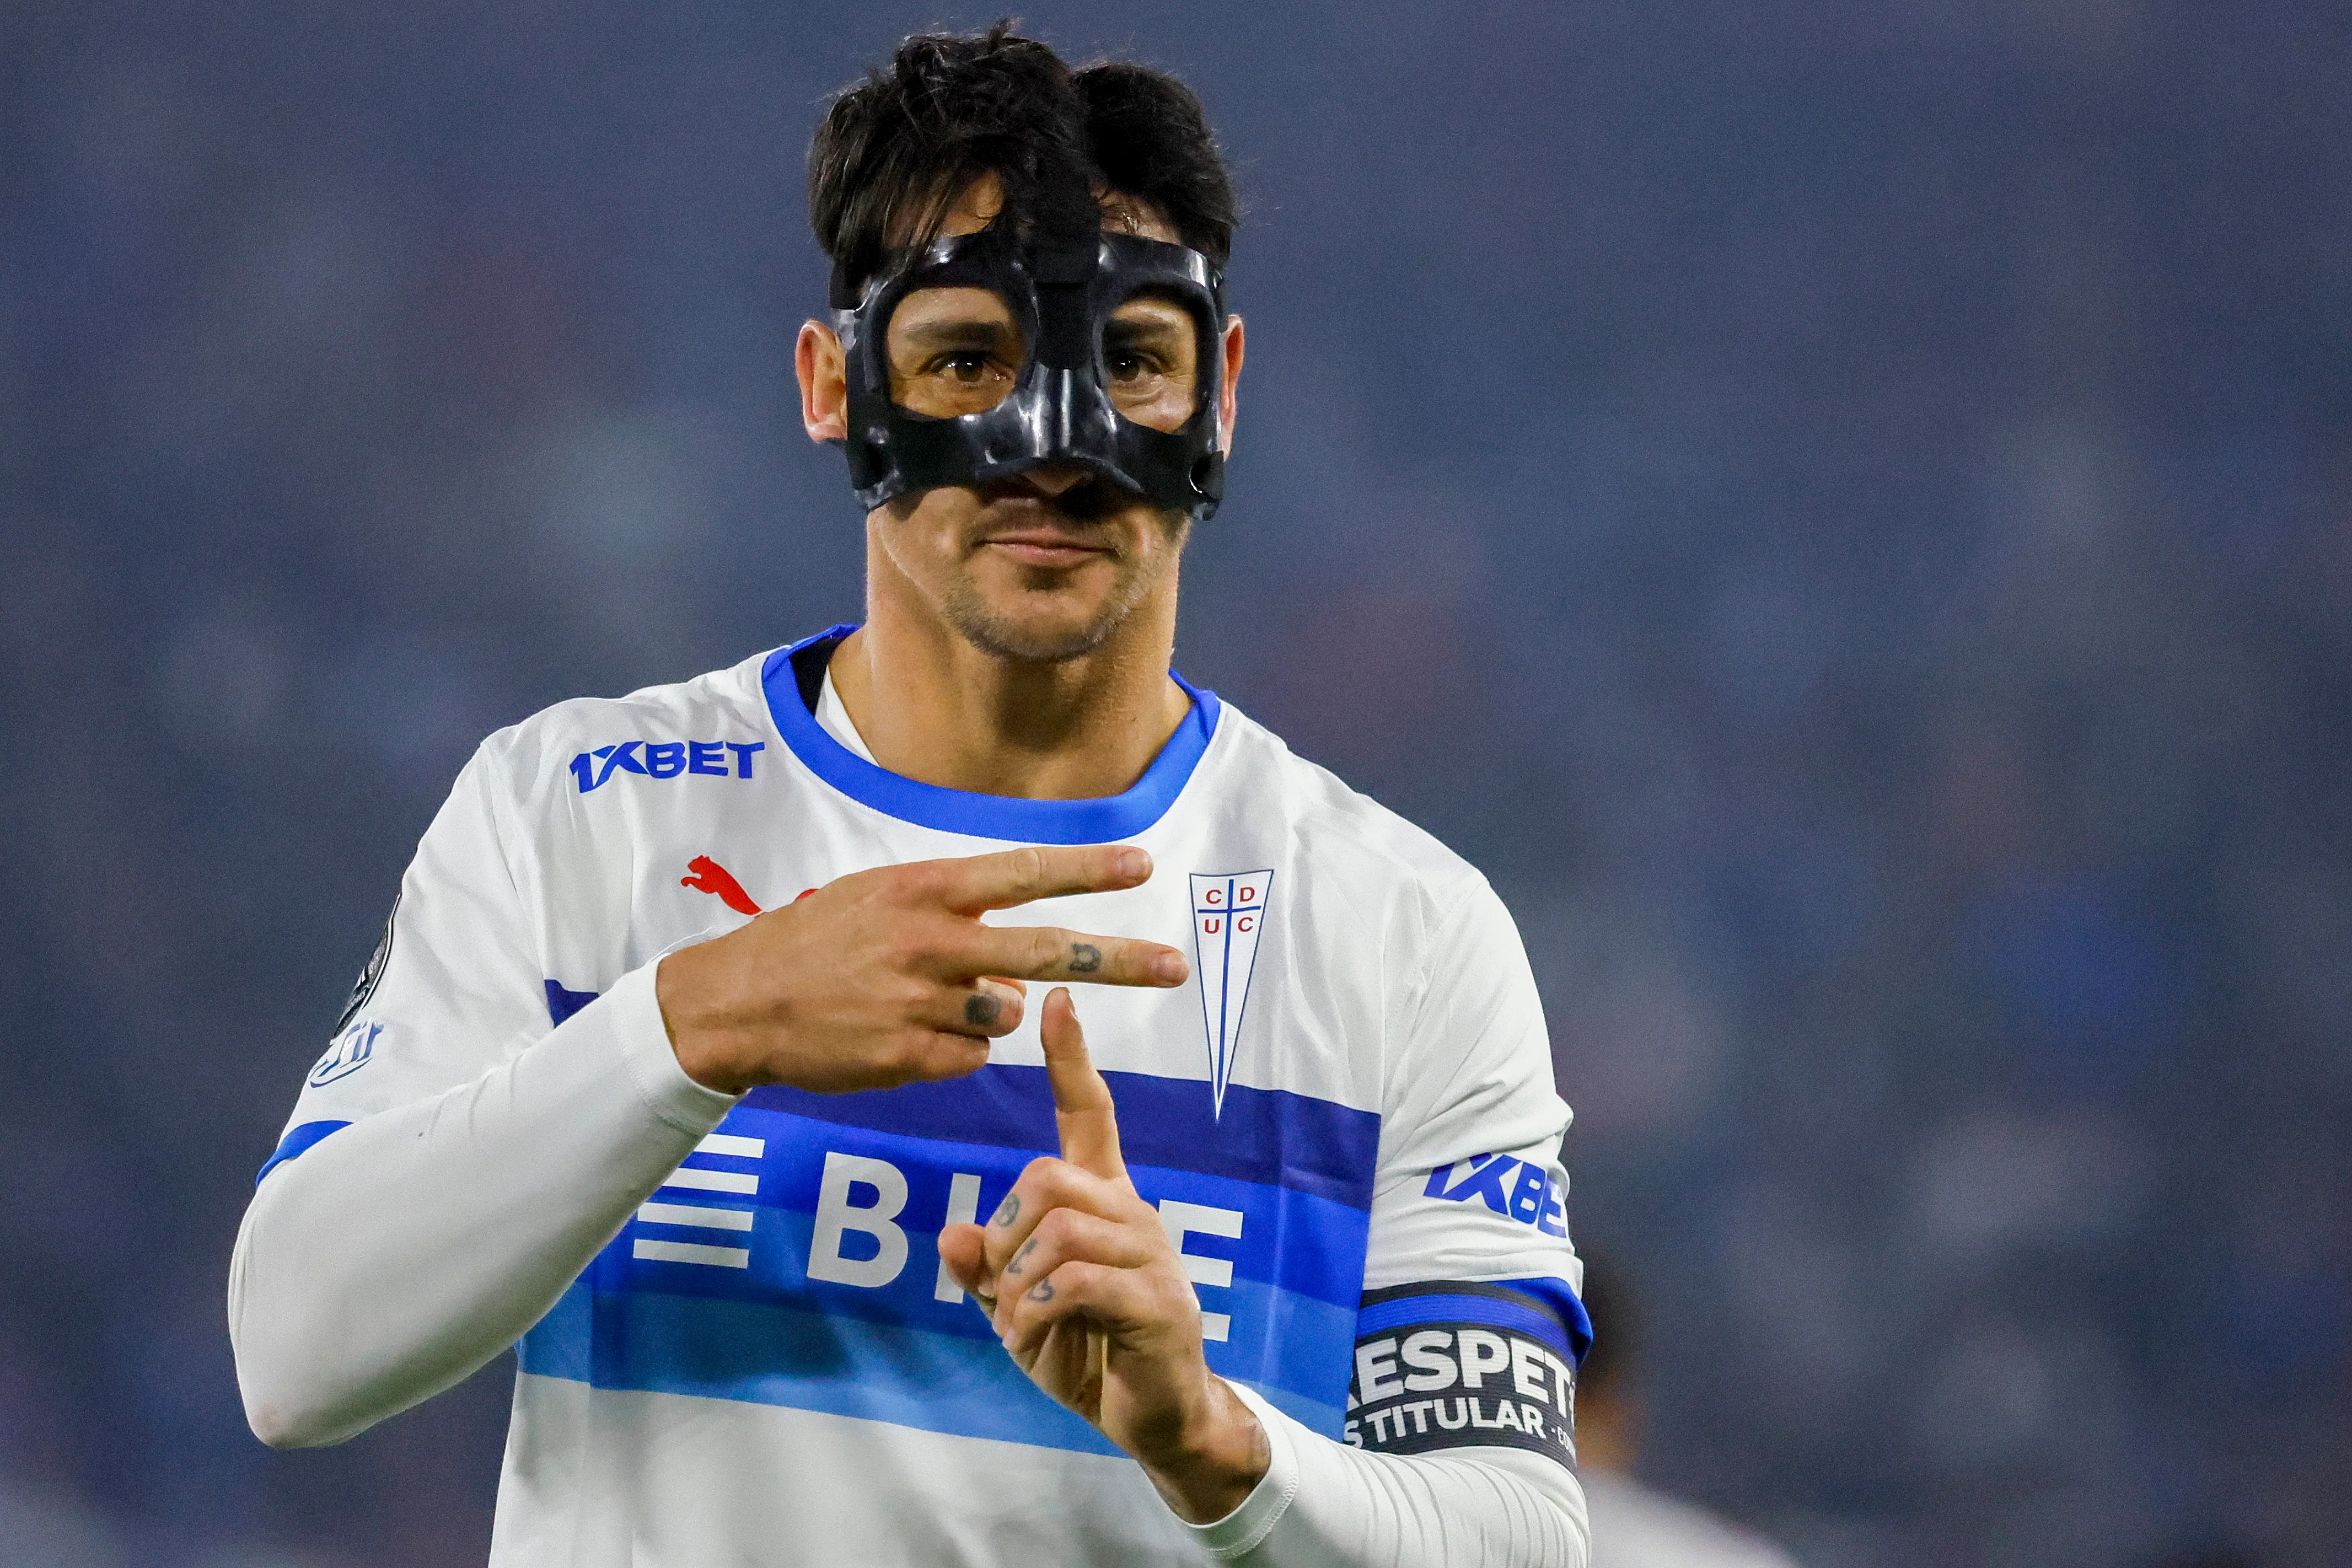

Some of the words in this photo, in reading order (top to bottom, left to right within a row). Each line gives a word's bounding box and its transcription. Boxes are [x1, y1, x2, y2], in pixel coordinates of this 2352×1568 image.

[570, 742, 765, 793] 1XBET
[807, 1151, 1243, 1342] BIE
[1347, 1329, 1576, 1430] ESPET
[1365, 1397, 1546, 1443] TITULAR
